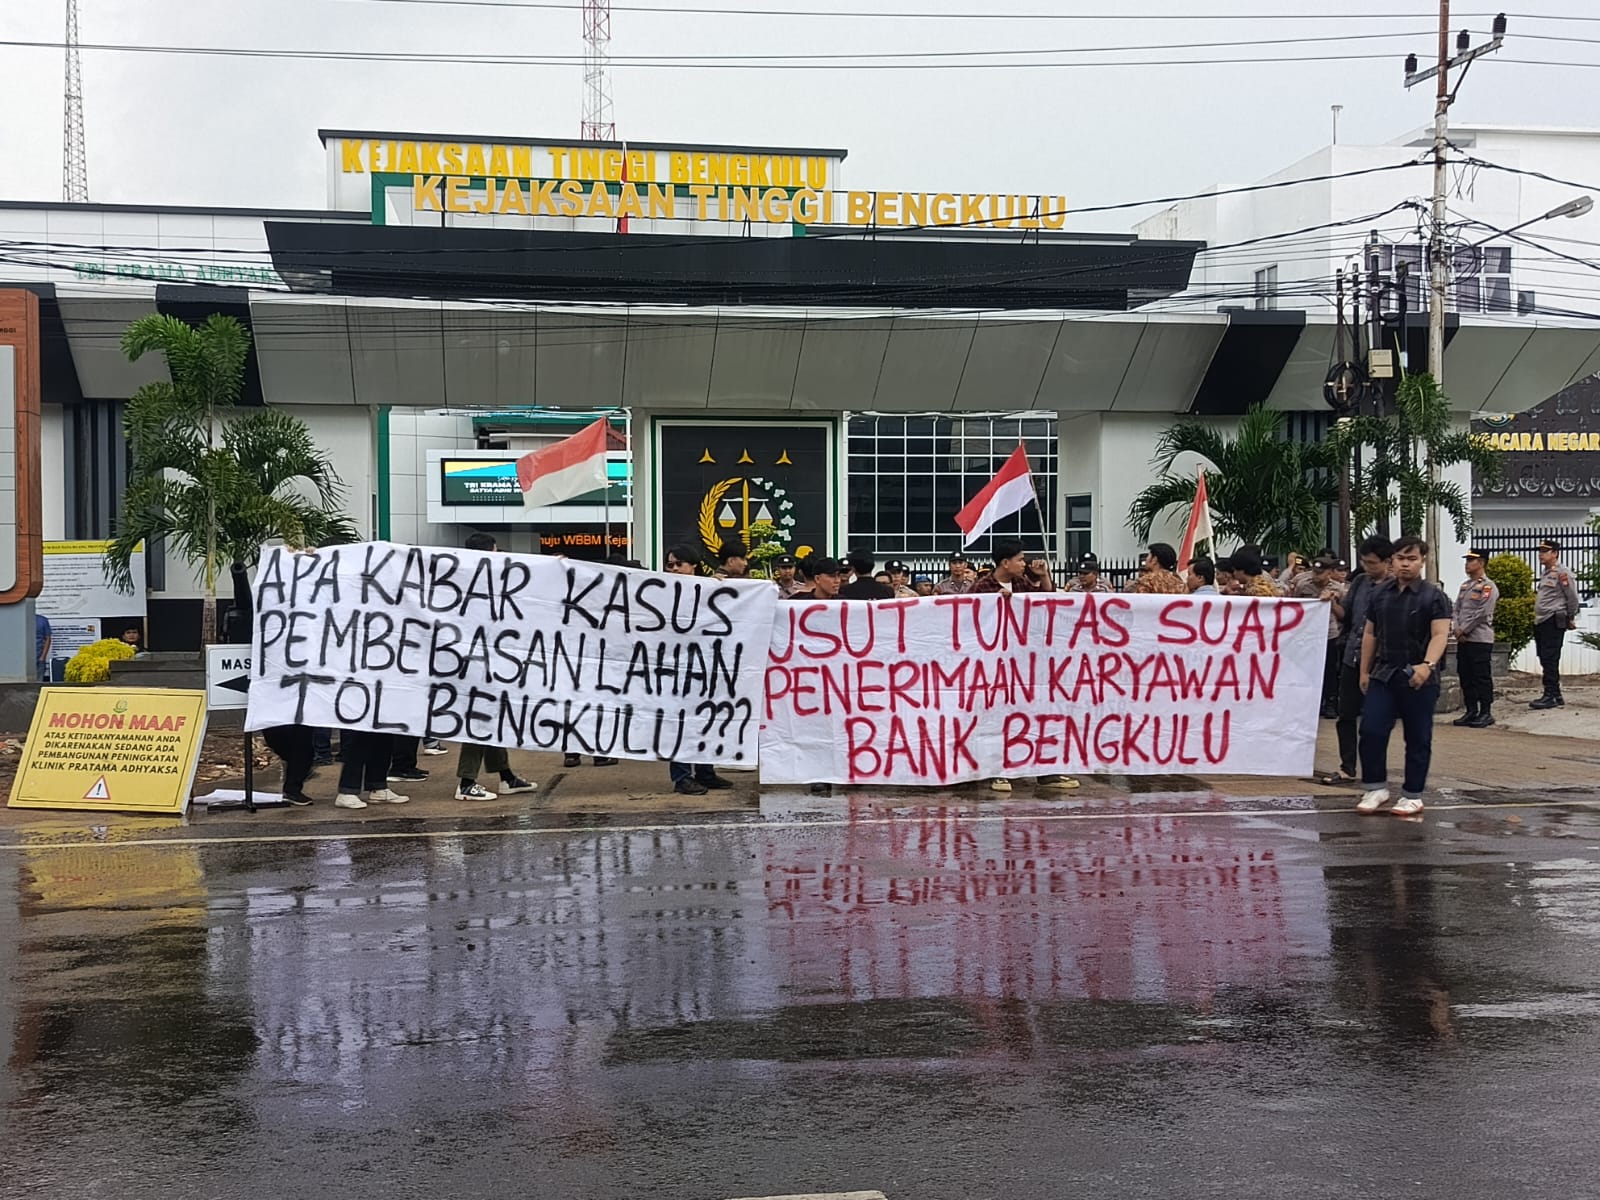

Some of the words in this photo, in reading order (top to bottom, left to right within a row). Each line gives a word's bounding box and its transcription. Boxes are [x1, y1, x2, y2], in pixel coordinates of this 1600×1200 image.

[341, 139, 532, 175] KEJAKSAAN
[549, 147, 656, 184] TINGGI
[669, 152, 827, 189] BENGKULU
[413, 175, 675, 219] KEJAKSAAN
[689, 184, 832, 225] TINGGI
[847, 191, 1067, 230] BENGKULU
[563, 534, 601, 545] WBBM
[256, 547, 341, 613] APA
[361, 545, 531, 621] KABAR
[562, 567, 739, 636] KASUS
[934, 592, 1131, 652] TUNTAS
[1157, 599, 1305, 653] SUAP
[259, 607, 586, 692] PEMBEBASAN
[595, 637, 743, 700] LAHAN
[280, 671, 410, 732] TOL
[764, 652, 1037, 721] PENERIMAAN
[1049, 651, 1280, 706] KARYAWAN
[44, 731, 66, 740] ATAS
[68, 732, 154, 741] KETIDAKNYAMANAN
[156, 735, 181, 743] ANDA
[44, 741, 112, 750] DIKARENAKAN
[113, 743, 153, 752] SEDANG
[48, 713, 125, 730] MOHON
[128, 714, 187, 732] MAAF
[844, 714, 979, 783] BANK
[1003, 709, 1231, 769] BENGKULU
[31, 760, 65, 770] KLINIK
[68, 762, 117, 772] PRATAMA
[120, 764, 179, 774] ADHYAKSA
[38, 750, 109, 760] PEMBANGUNAN
[111, 752, 179, 762] PENINGKATAN
